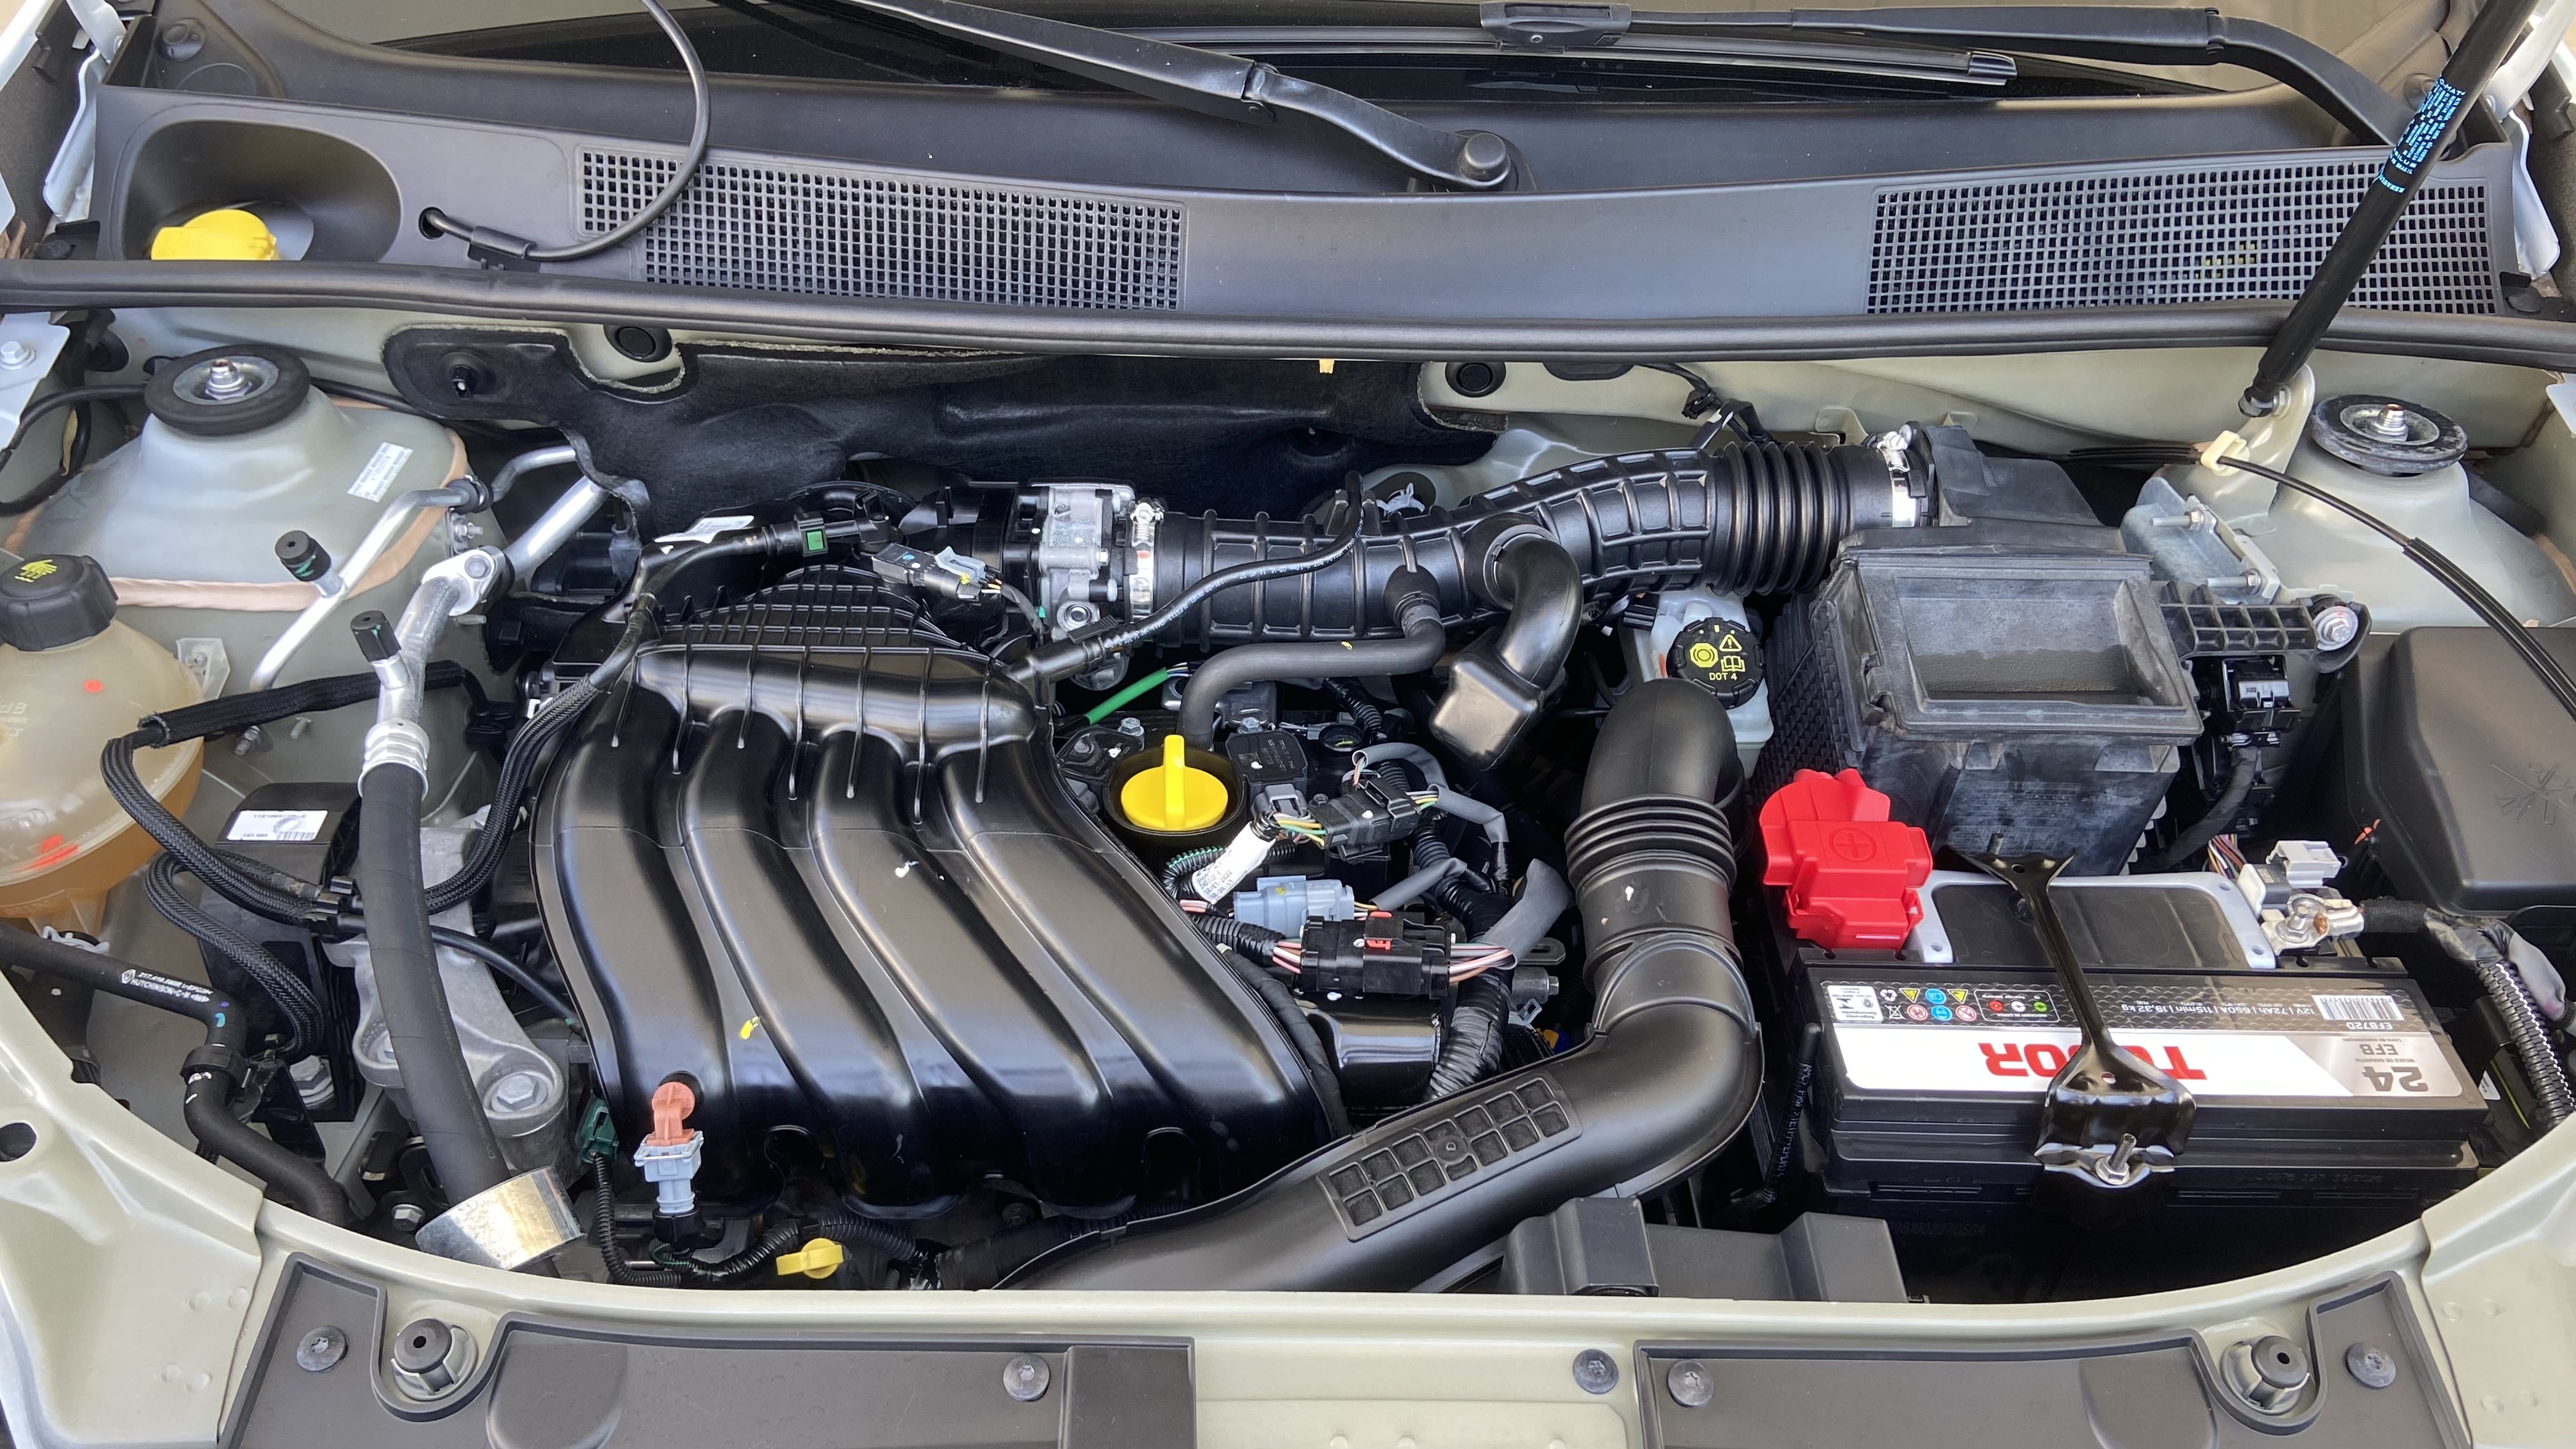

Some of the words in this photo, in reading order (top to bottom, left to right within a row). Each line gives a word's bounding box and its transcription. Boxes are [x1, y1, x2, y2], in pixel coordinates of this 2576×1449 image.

[2345, 1022, 2393, 1030] EFB72D
[2359, 1044, 2398, 1055] EFB
[1978, 1043, 2207, 1080] TOR
[2361, 1066, 2428, 1092] 24
